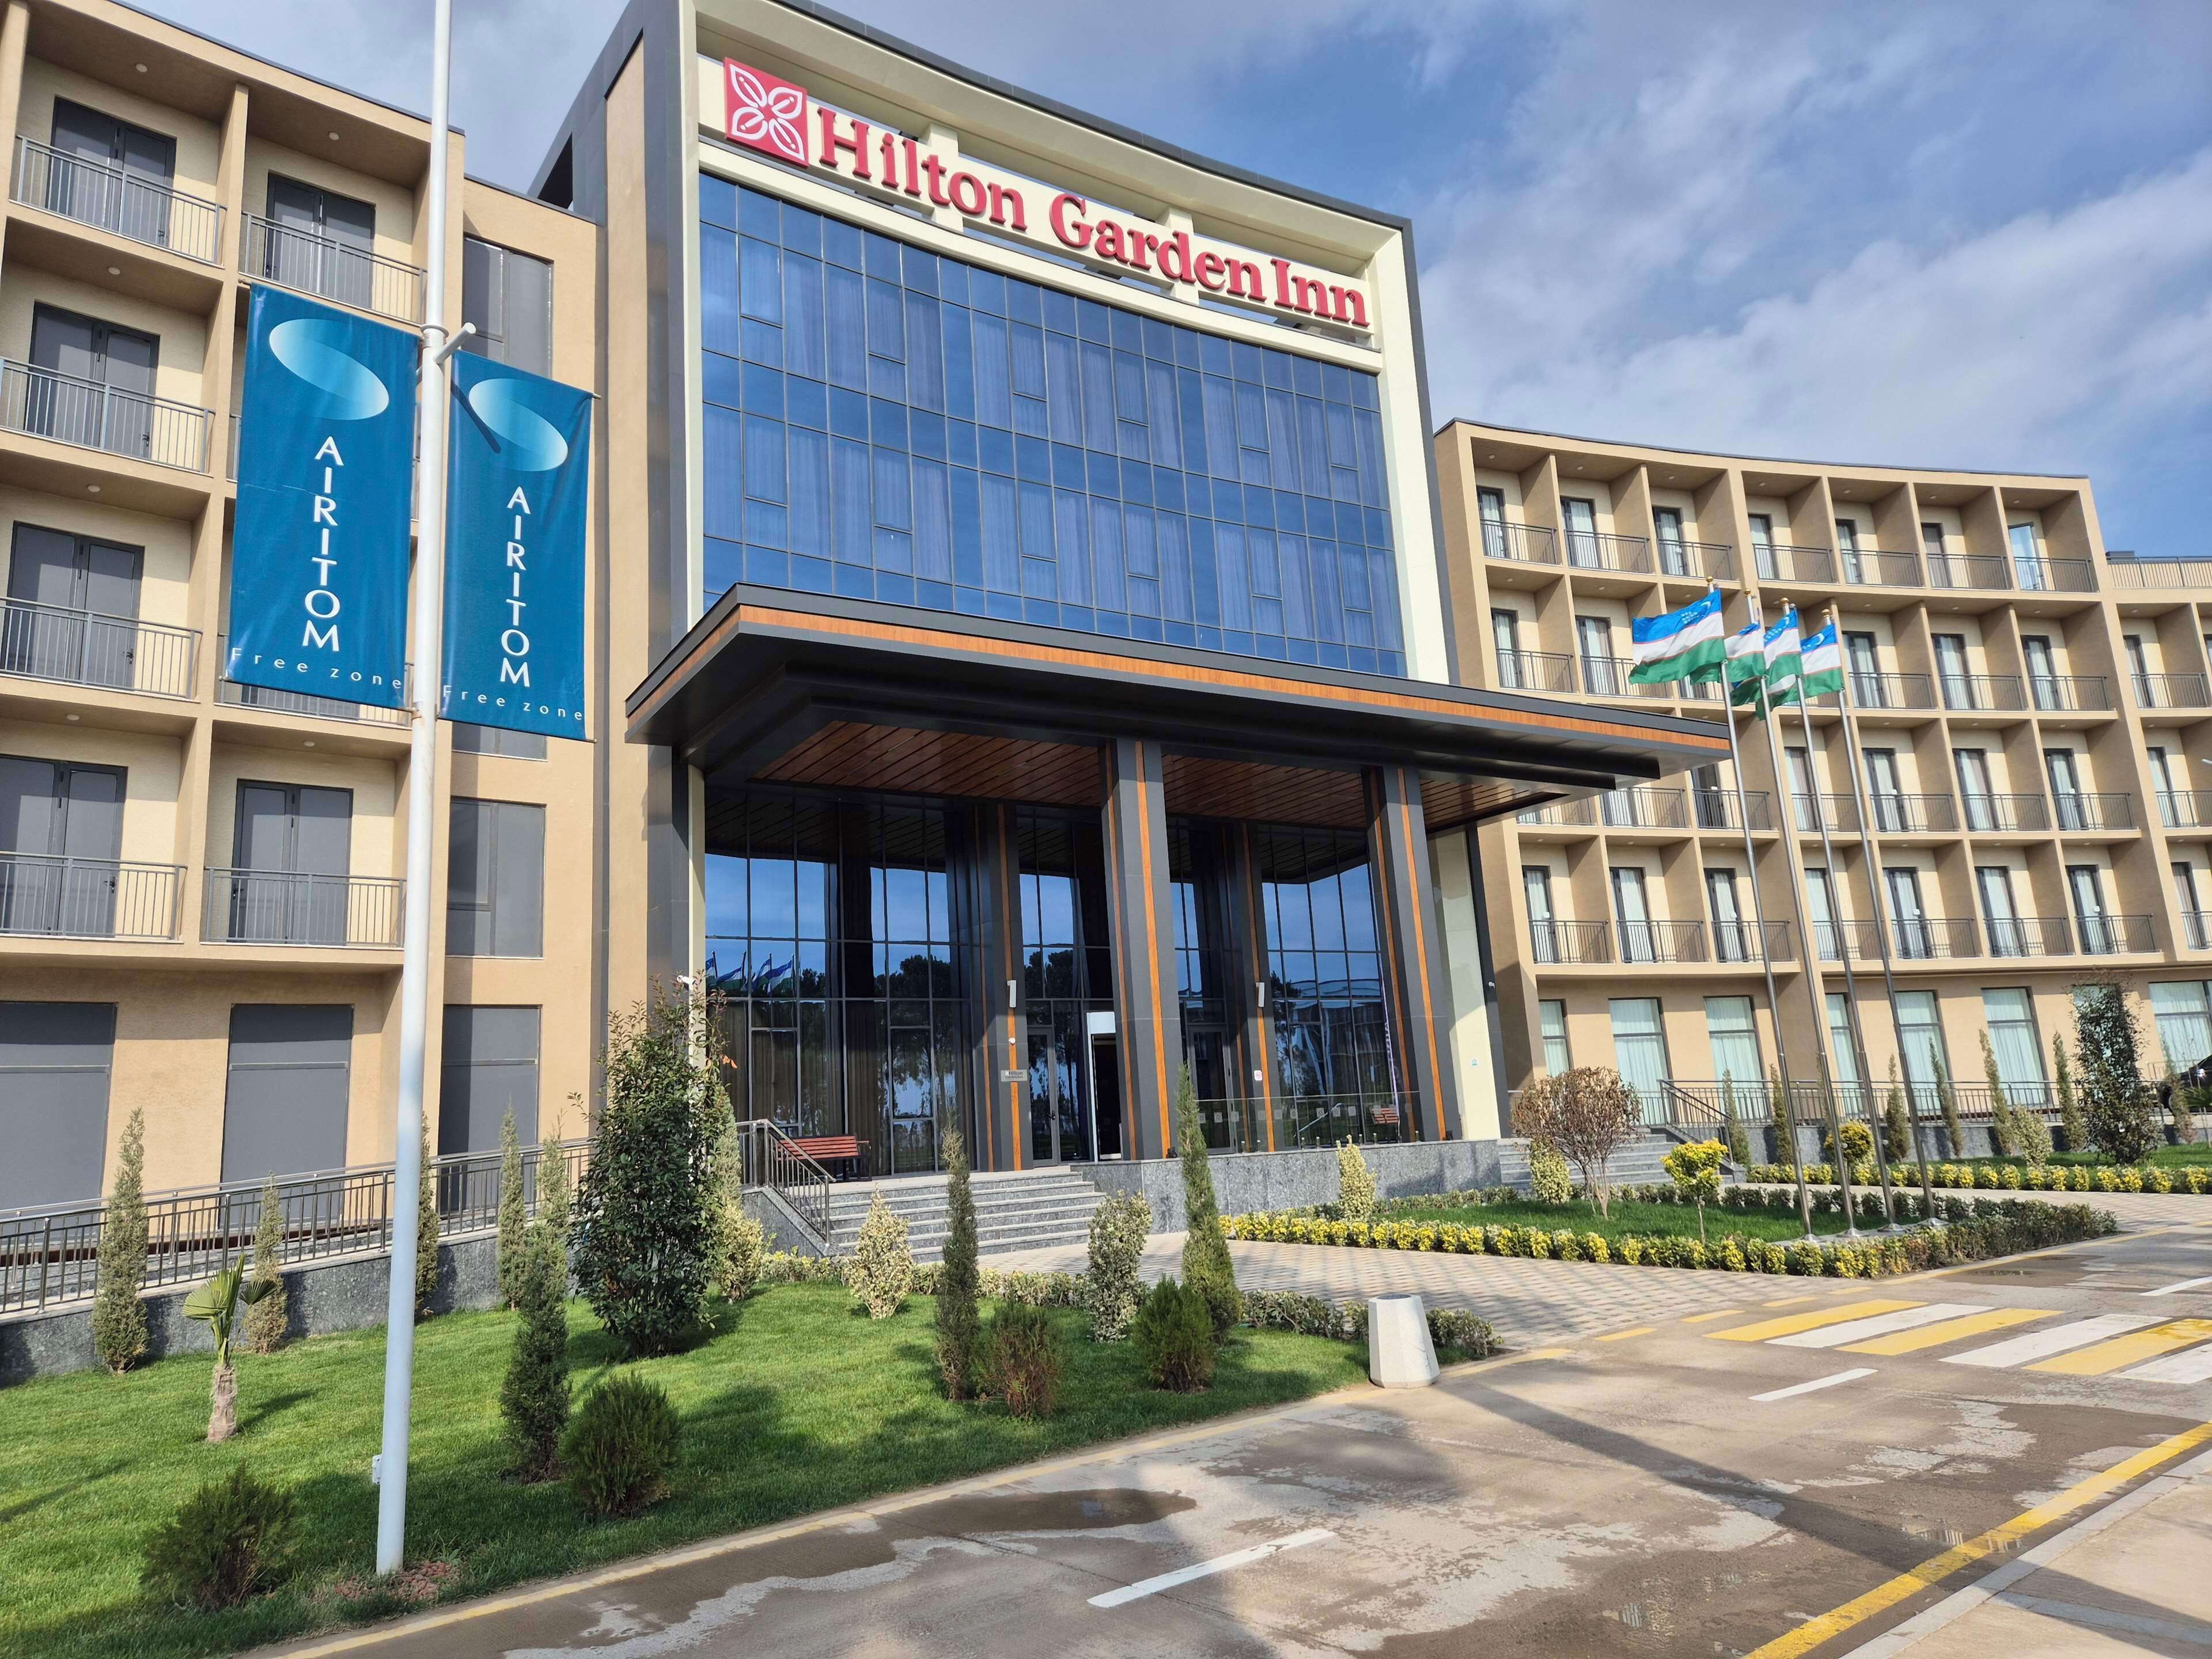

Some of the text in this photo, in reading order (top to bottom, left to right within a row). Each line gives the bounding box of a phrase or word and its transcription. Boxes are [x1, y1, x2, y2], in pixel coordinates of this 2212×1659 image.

[817, 106, 1370, 327] Hilton Garden Inn
[303, 436, 344, 653] AIRITOM
[500, 486, 531, 688] AIRITOM
[230, 646, 402, 690] Free zone
[442, 684, 584, 721] Free zone
